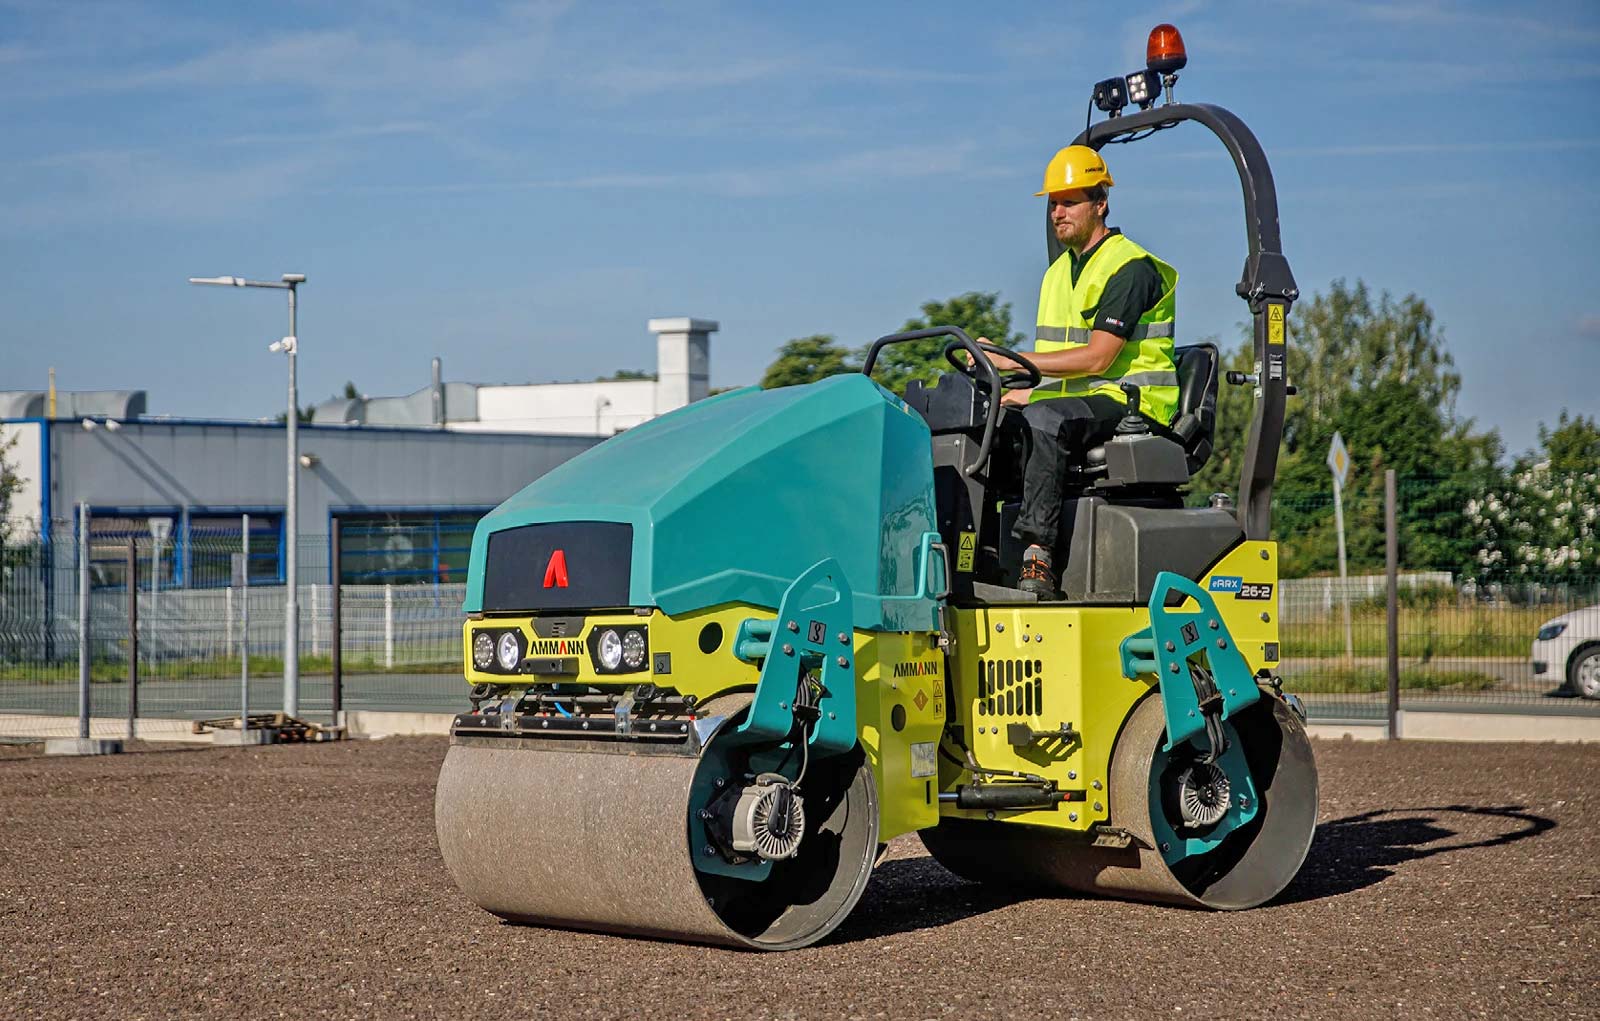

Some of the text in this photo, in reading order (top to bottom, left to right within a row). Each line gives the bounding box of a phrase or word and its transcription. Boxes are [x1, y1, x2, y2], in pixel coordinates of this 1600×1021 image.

[1212, 579, 1238, 588] eARX
[1241, 585, 1271, 597] 26-2
[530, 640, 585, 655] AMMANN
[893, 661, 938, 678] AMMANN
